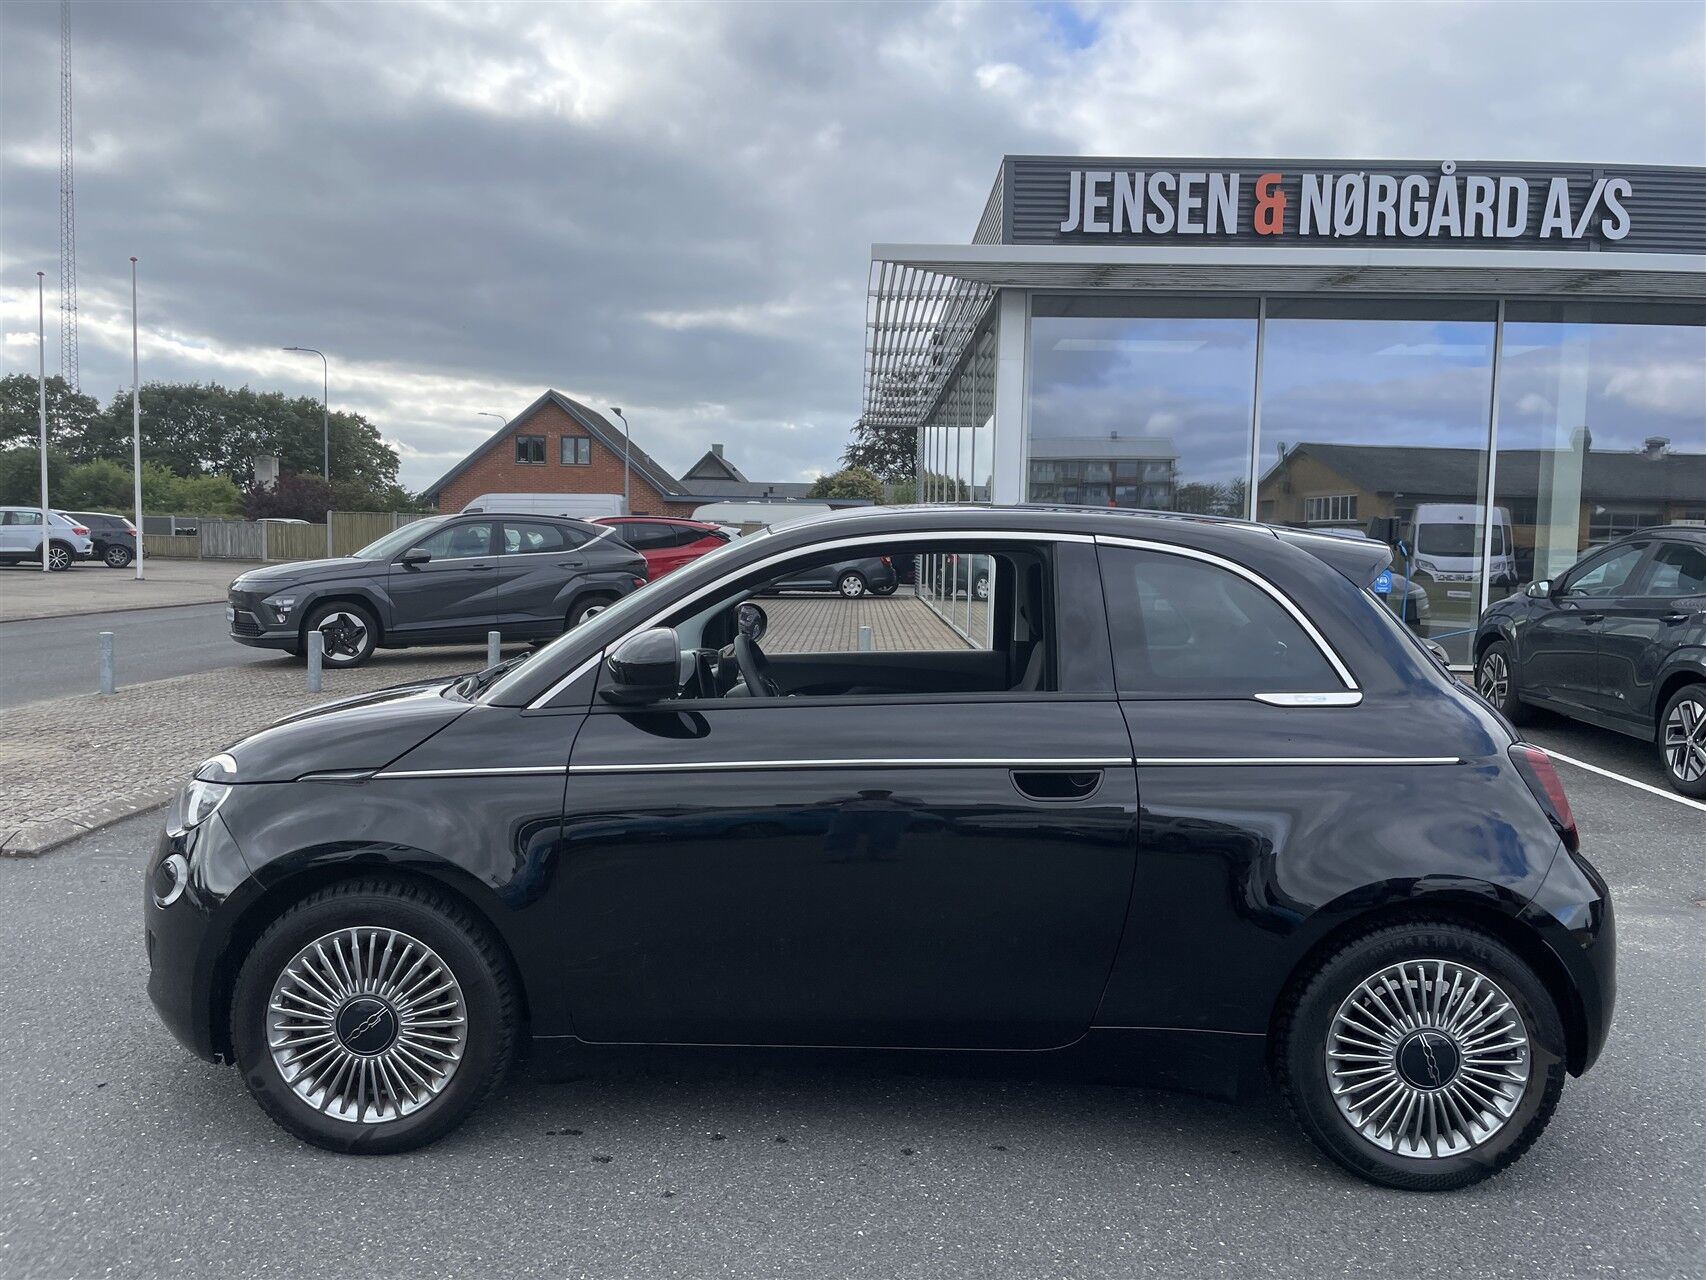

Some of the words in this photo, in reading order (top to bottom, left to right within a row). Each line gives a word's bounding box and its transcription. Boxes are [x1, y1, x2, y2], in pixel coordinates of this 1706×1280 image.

[1060, 170, 1240, 234] JENSEN
[1254, 173, 1287, 235] &
[1299, 160, 1529, 238] NØRGÅRD
[1539, 177, 1633, 240] A/S
